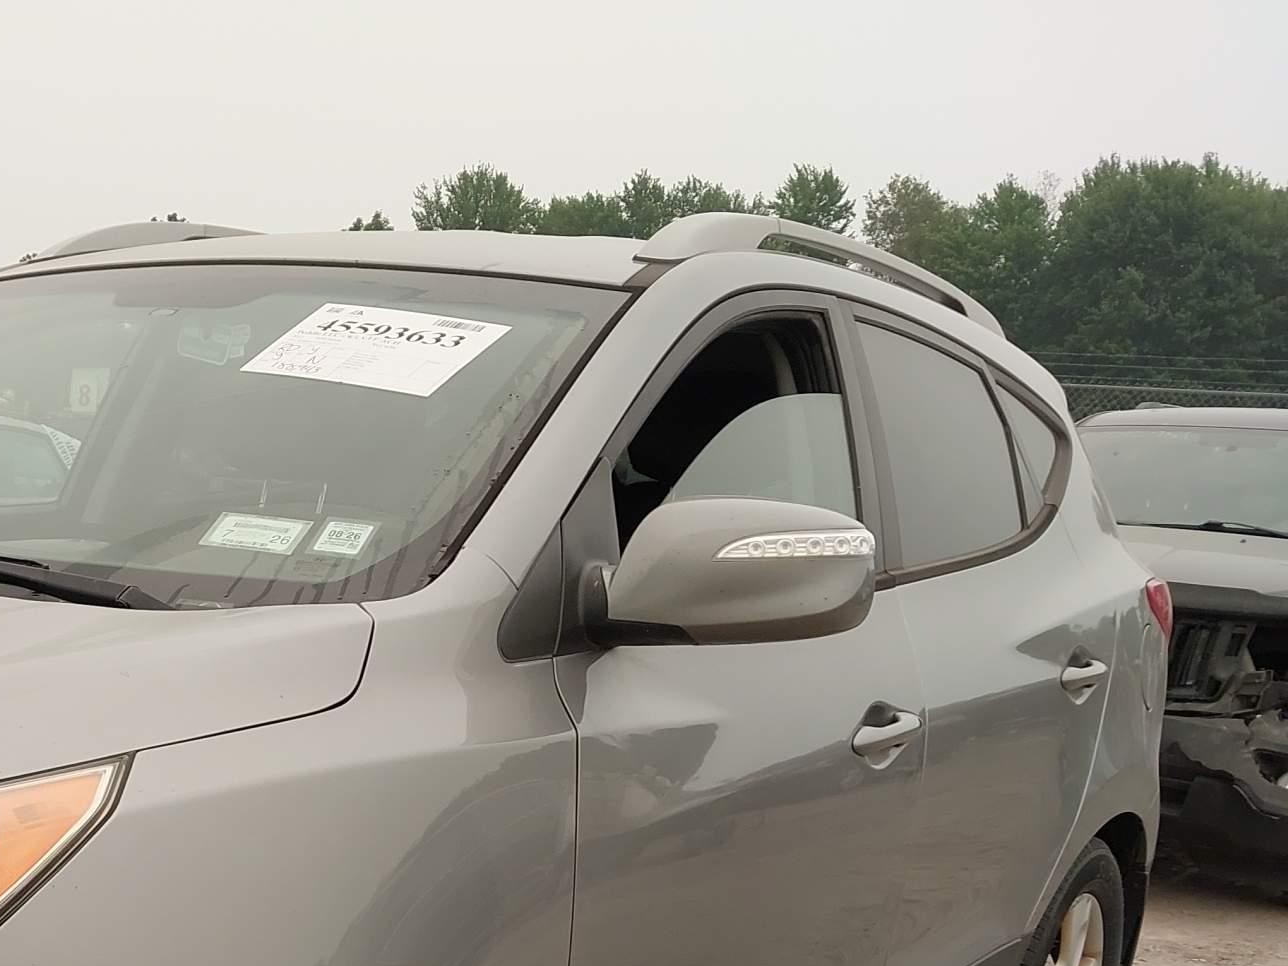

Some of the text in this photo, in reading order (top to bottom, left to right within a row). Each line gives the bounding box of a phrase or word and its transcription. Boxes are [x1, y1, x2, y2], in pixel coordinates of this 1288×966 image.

[316, 319, 466, 348] 45593633
[79, 384, 91, 407] 8
[270, 534, 292, 546] 26
